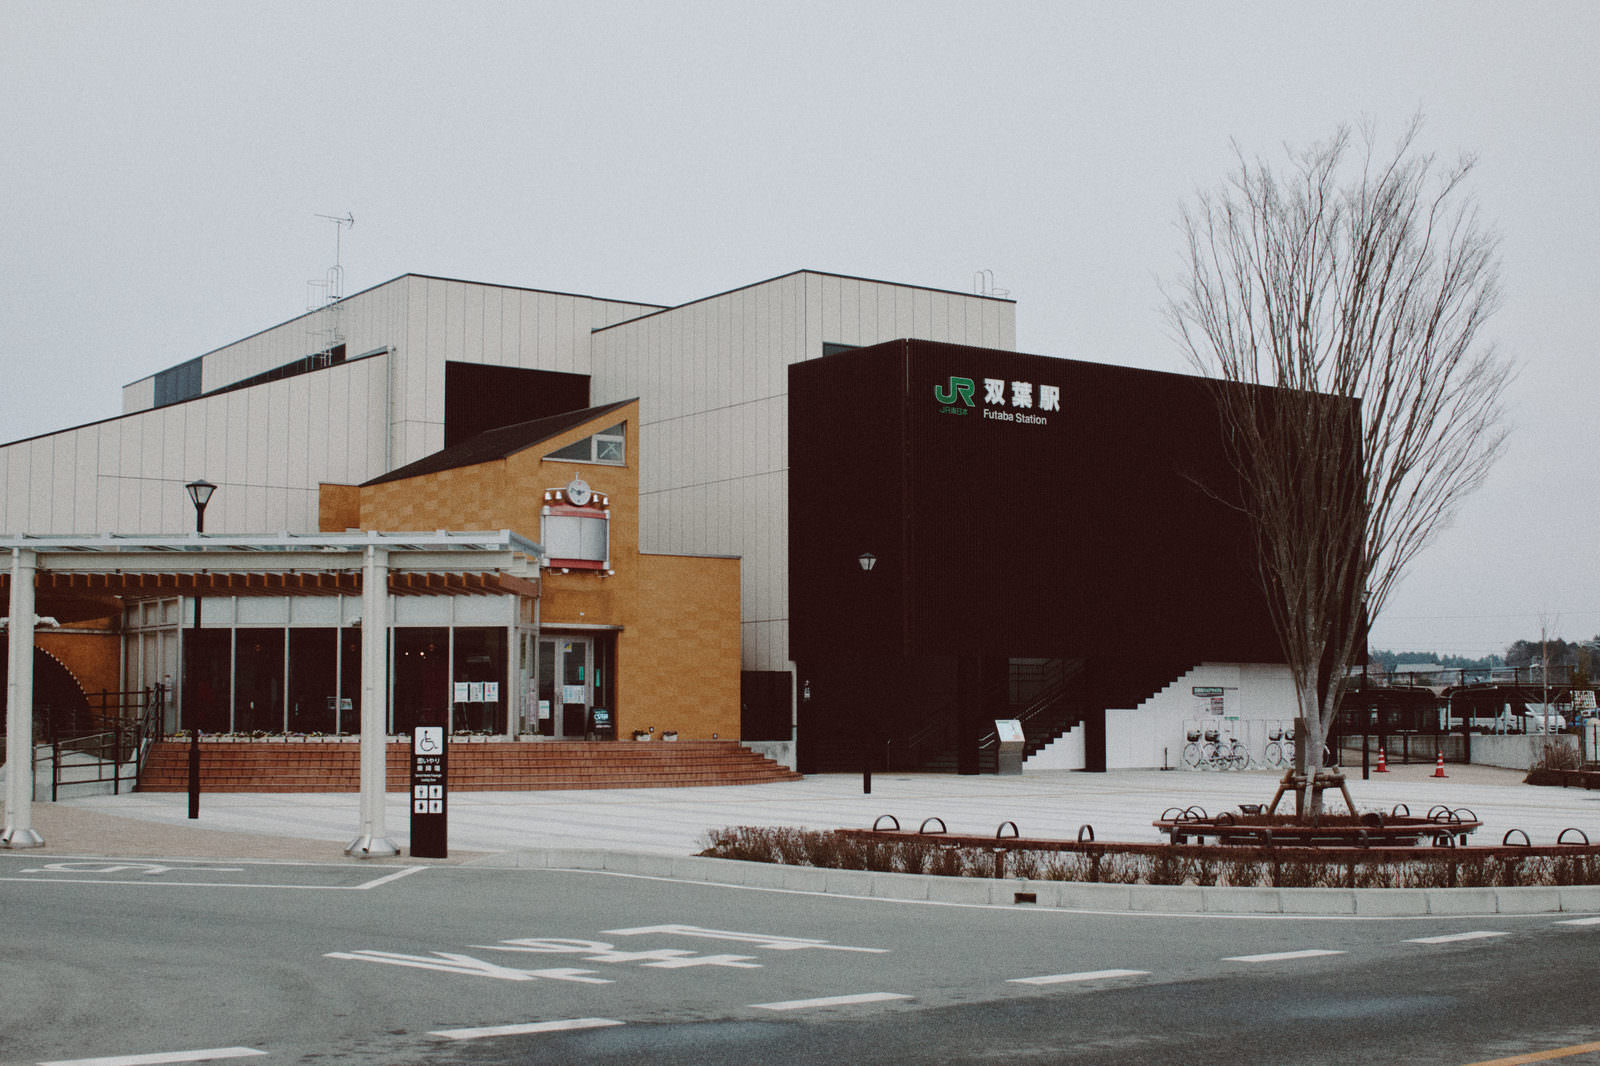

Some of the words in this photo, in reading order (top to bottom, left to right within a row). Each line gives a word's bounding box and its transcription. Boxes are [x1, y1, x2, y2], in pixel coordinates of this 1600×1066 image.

[935, 376, 976, 407] JR
[983, 378, 1060, 412] 双葉駅
[983, 408, 1014, 421] Futaba
[1015, 413, 1047, 425] Station
